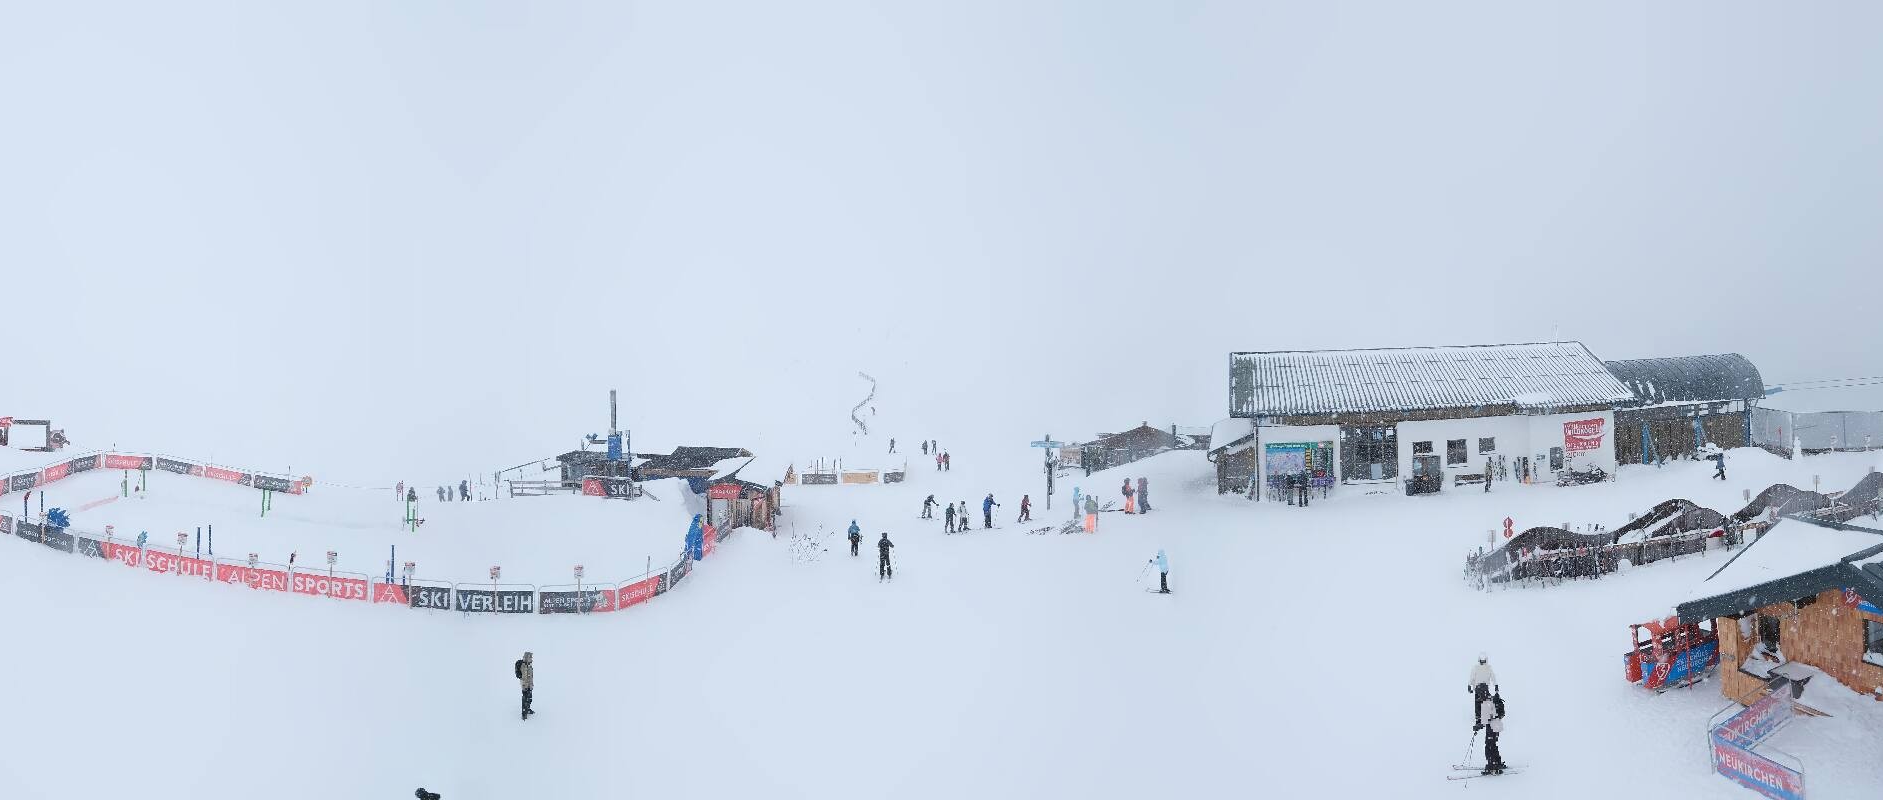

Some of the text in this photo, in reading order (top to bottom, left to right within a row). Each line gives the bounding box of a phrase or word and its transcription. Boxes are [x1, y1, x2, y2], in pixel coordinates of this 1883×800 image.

[610, 483, 630, 496] SKI
[115, 548, 141, 567] SKI
[294, 576, 364, 598] SPORTS
[418, 590, 533, 611] SKI VERLEIH
[1718, 750, 1783, 791] NEUKIRCHEN
